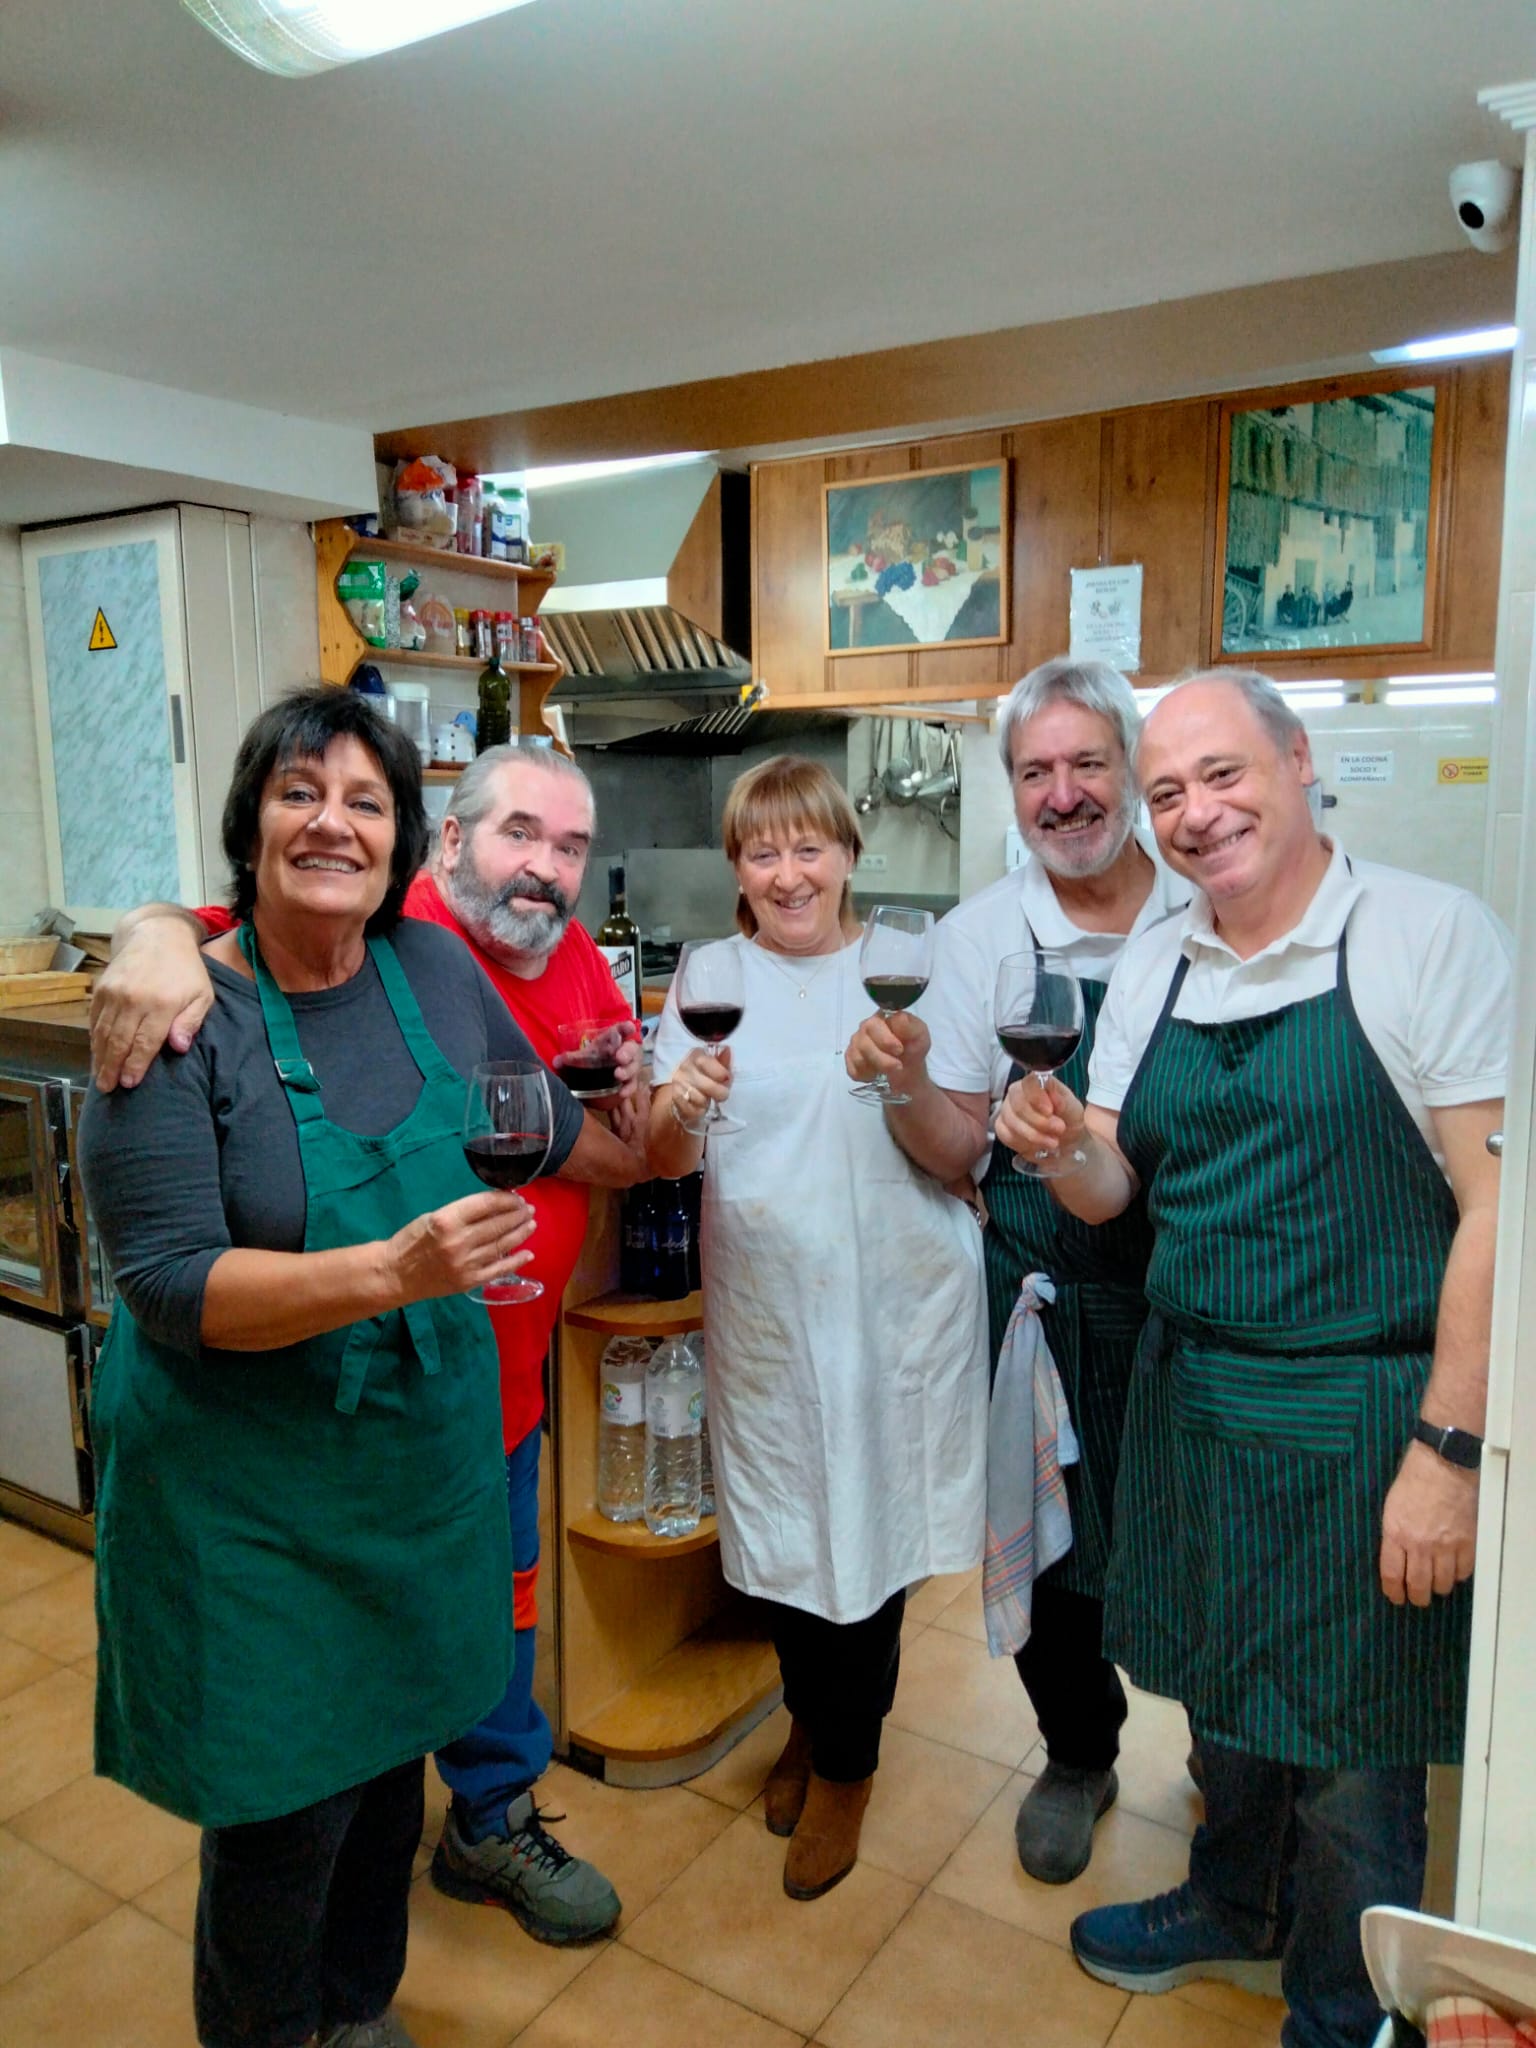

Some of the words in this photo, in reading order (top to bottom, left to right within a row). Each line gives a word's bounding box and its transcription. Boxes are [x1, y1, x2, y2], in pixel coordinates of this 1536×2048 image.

[1340, 755, 1350, 763] EN
[1351, 755, 1361, 763] LA
[1361, 755, 1388, 763] COCINA
